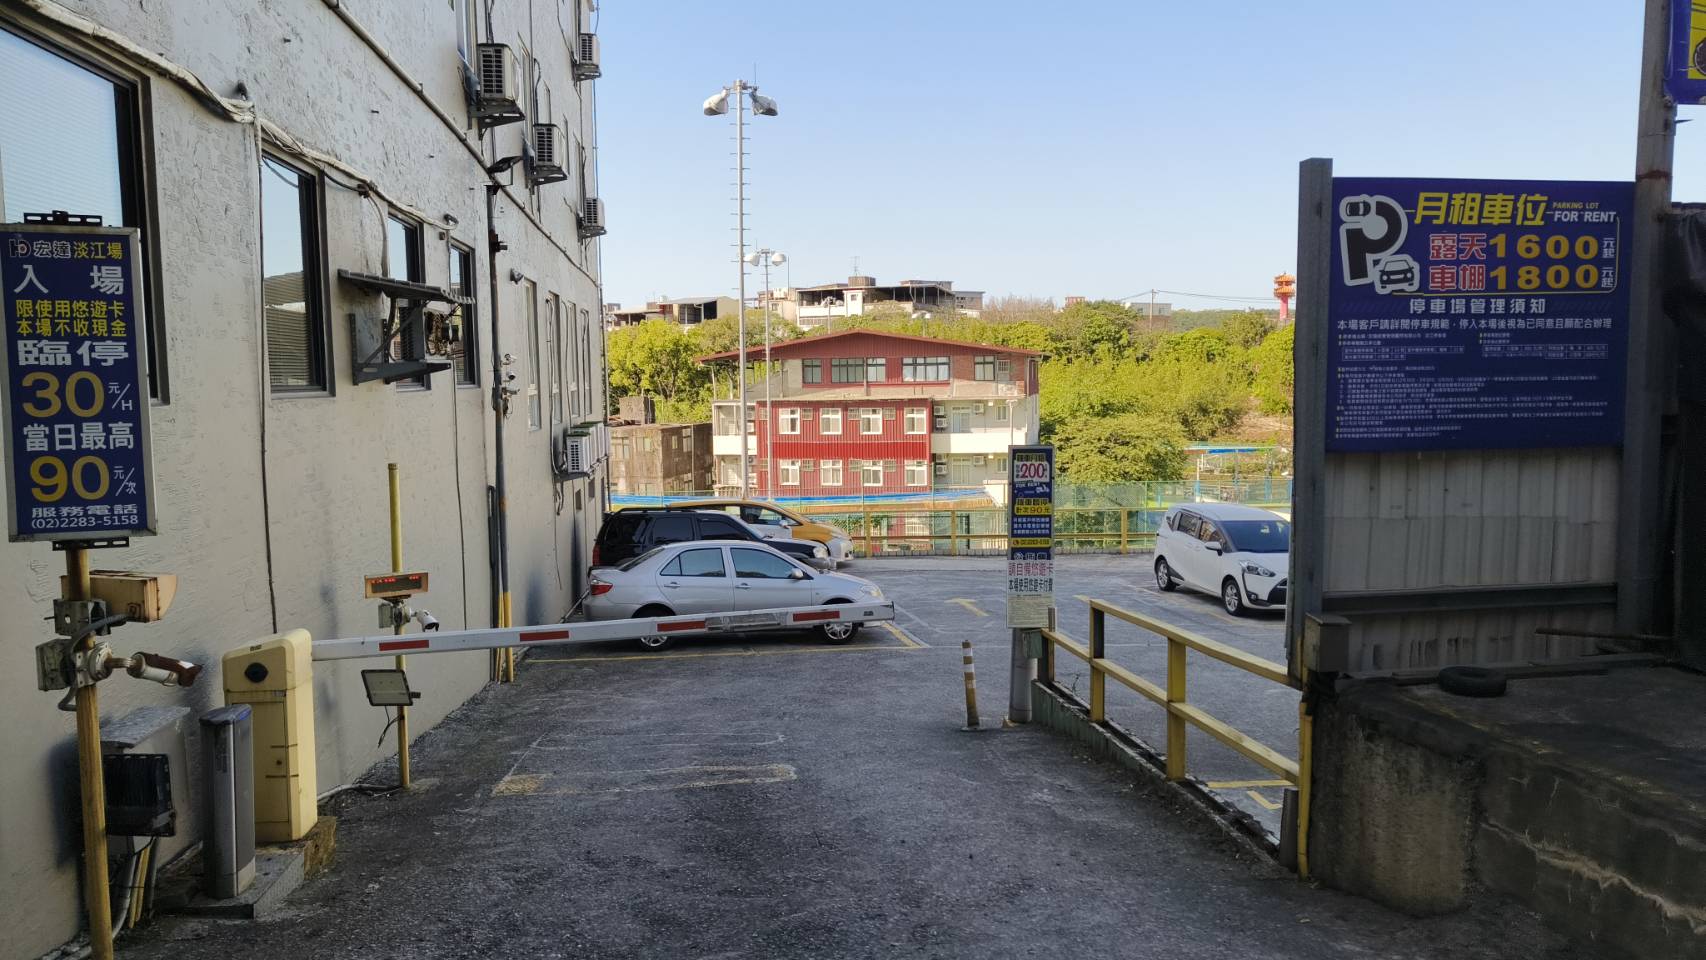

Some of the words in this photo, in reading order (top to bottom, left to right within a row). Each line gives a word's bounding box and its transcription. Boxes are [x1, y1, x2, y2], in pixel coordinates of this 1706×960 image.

[1414, 191, 1549, 226] 月租車位
[1554, 211, 1579, 222] FOR
[1584, 211, 1617, 223] RENT
[1429, 233, 1487, 260] 露天
[1489, 234, 1598, 260] 1600
[1429, 264, 1487, 291] 車棚
[1490, 264, 1599, 290] 1800
[16, 299, 125, 318] 限使用悠遊卡
[1409, 298, 1546, 314] 停車場管理須知
[16, 319, 127, 337] 本場不收現金
[17, 339, 129, 367] 臨停
[22, 371, 104, 417] 30
[23, 421, 134, 451] 當日最高
[30, 455, 110, 502] 90
[1020, 463, 1045, 479] 200
[31, 504, 137, 518] 服務電話
[31, 515, 138, 529] (02)2283-5158
